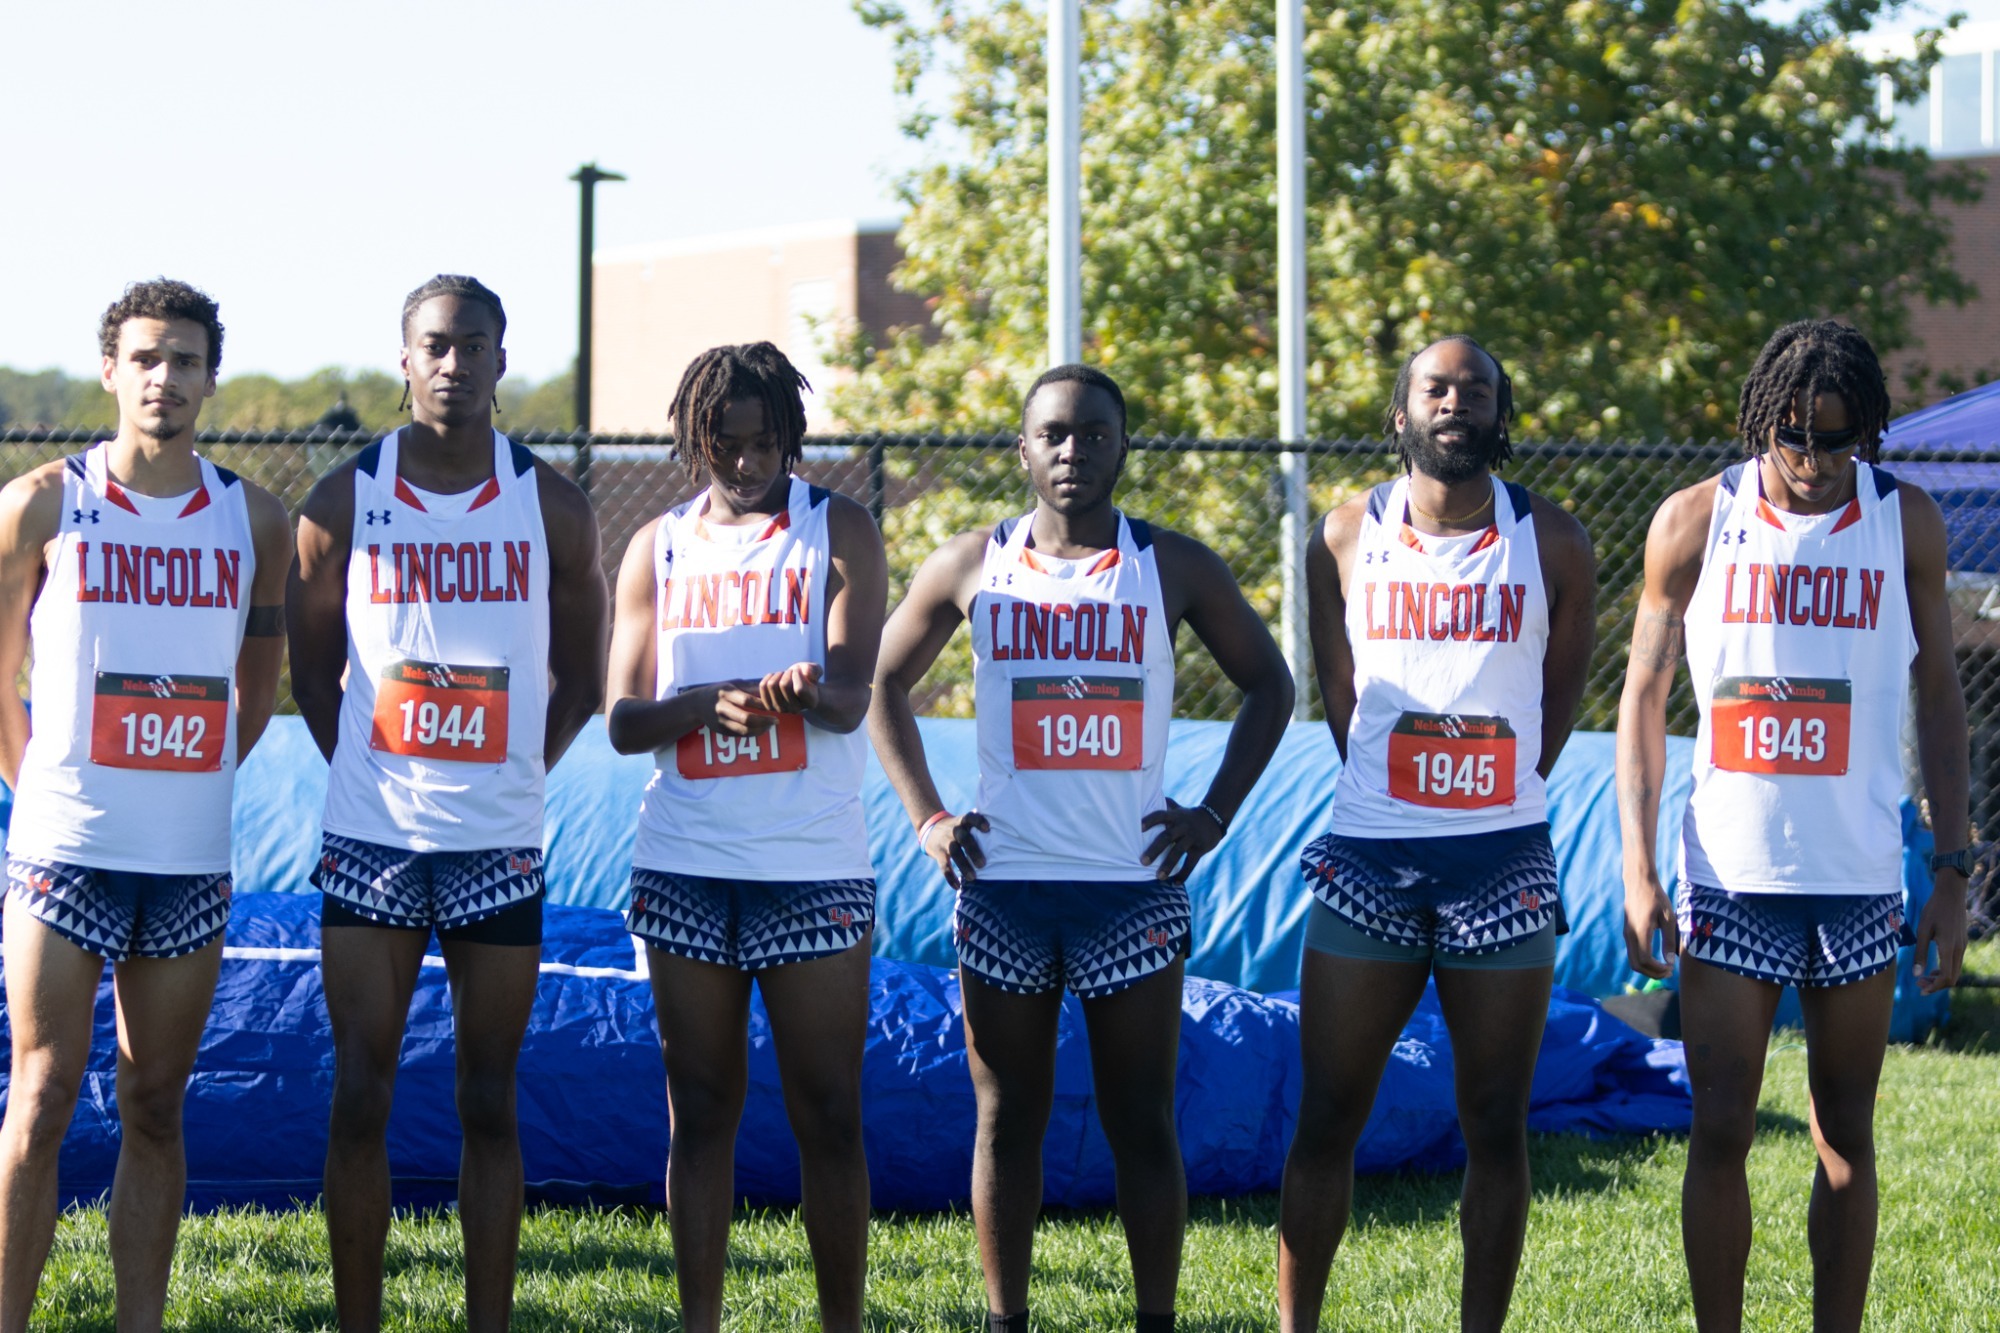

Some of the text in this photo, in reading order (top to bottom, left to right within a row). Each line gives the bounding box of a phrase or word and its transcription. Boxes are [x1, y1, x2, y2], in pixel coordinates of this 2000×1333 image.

[76, 541, 240, 609] LINCOLN
[368, 541, 530, 604] LINCOLN
[662, 567, 812, 631] LINCOLN
[1365, 581, 1526, 643] LINCOLN
[1722, 563, 1884, 630] LINCOLN
[990, 602, 1148, 664] LINCOLN
[121, 712, 206, 759] 1942
[400, 699, 486, 749] 1944
[698, 724, 780, 766] 1941
[1037, 714, 1121, 757] 1940
[1738, 716, 1827, 763] 1943
[1413, 752, 1496, 797] 1945
[829, 906, 852, 928] LU
[1518, 890, 1540, 911] LU
[1146, 927, 1168, 948] LU
